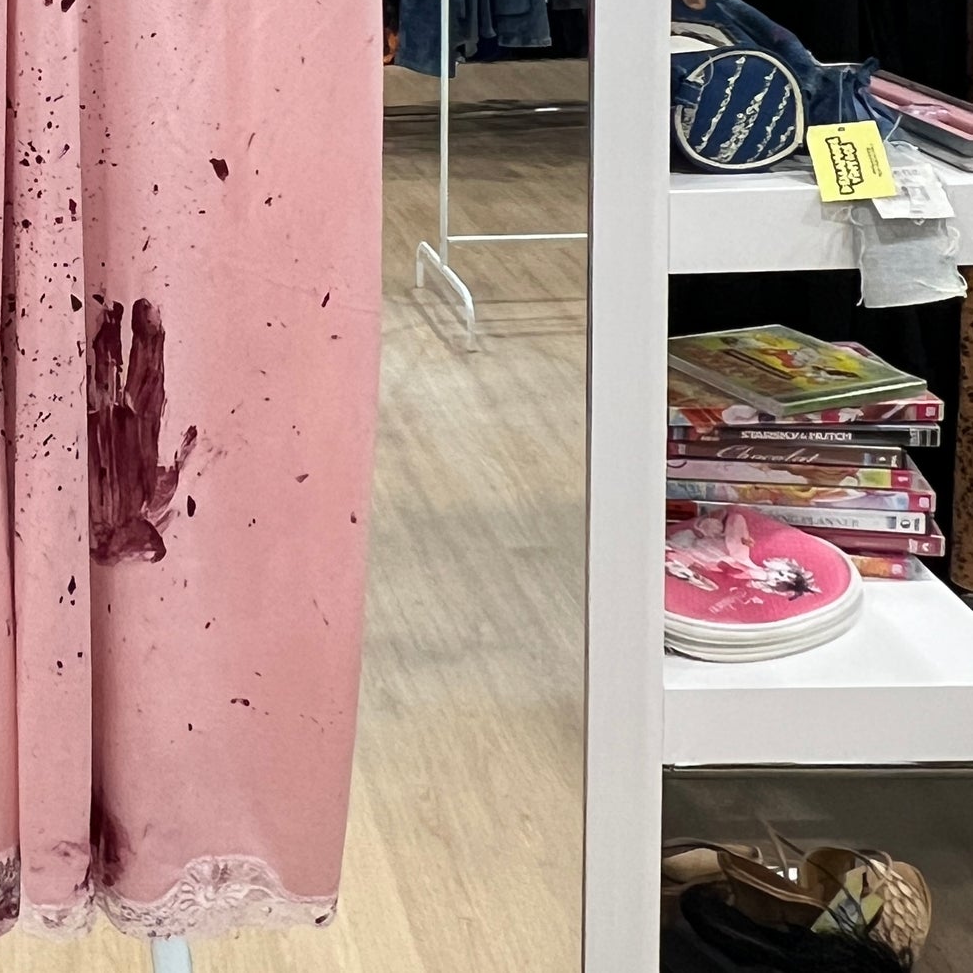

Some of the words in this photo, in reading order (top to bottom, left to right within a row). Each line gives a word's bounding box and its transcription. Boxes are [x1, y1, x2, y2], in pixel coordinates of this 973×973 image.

[739, 430, 798, 440] STARSKY
[808, 431, 853, 441] HUTCH
[716, 444, 820, 464] Chocolat
[801, 515, 860, 528] PLANNER
